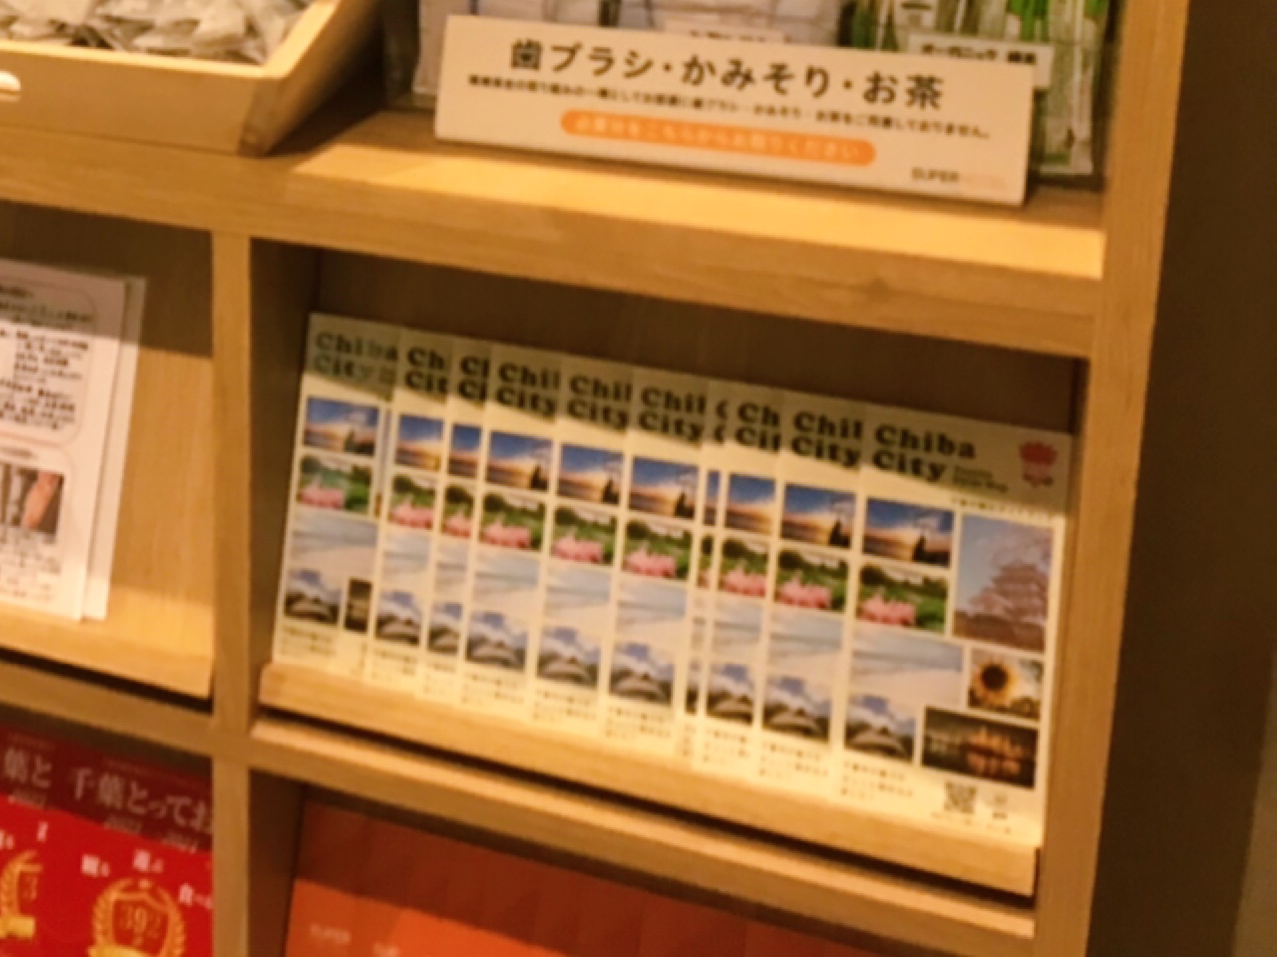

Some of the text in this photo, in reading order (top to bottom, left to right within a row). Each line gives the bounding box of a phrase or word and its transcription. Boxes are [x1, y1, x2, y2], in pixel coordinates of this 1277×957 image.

[510, 38, 944, 111] 歯ブラシ・かみそり・お茶
[875, 424, 976, 459] Chiba
[872, 449, 946, 484] City
